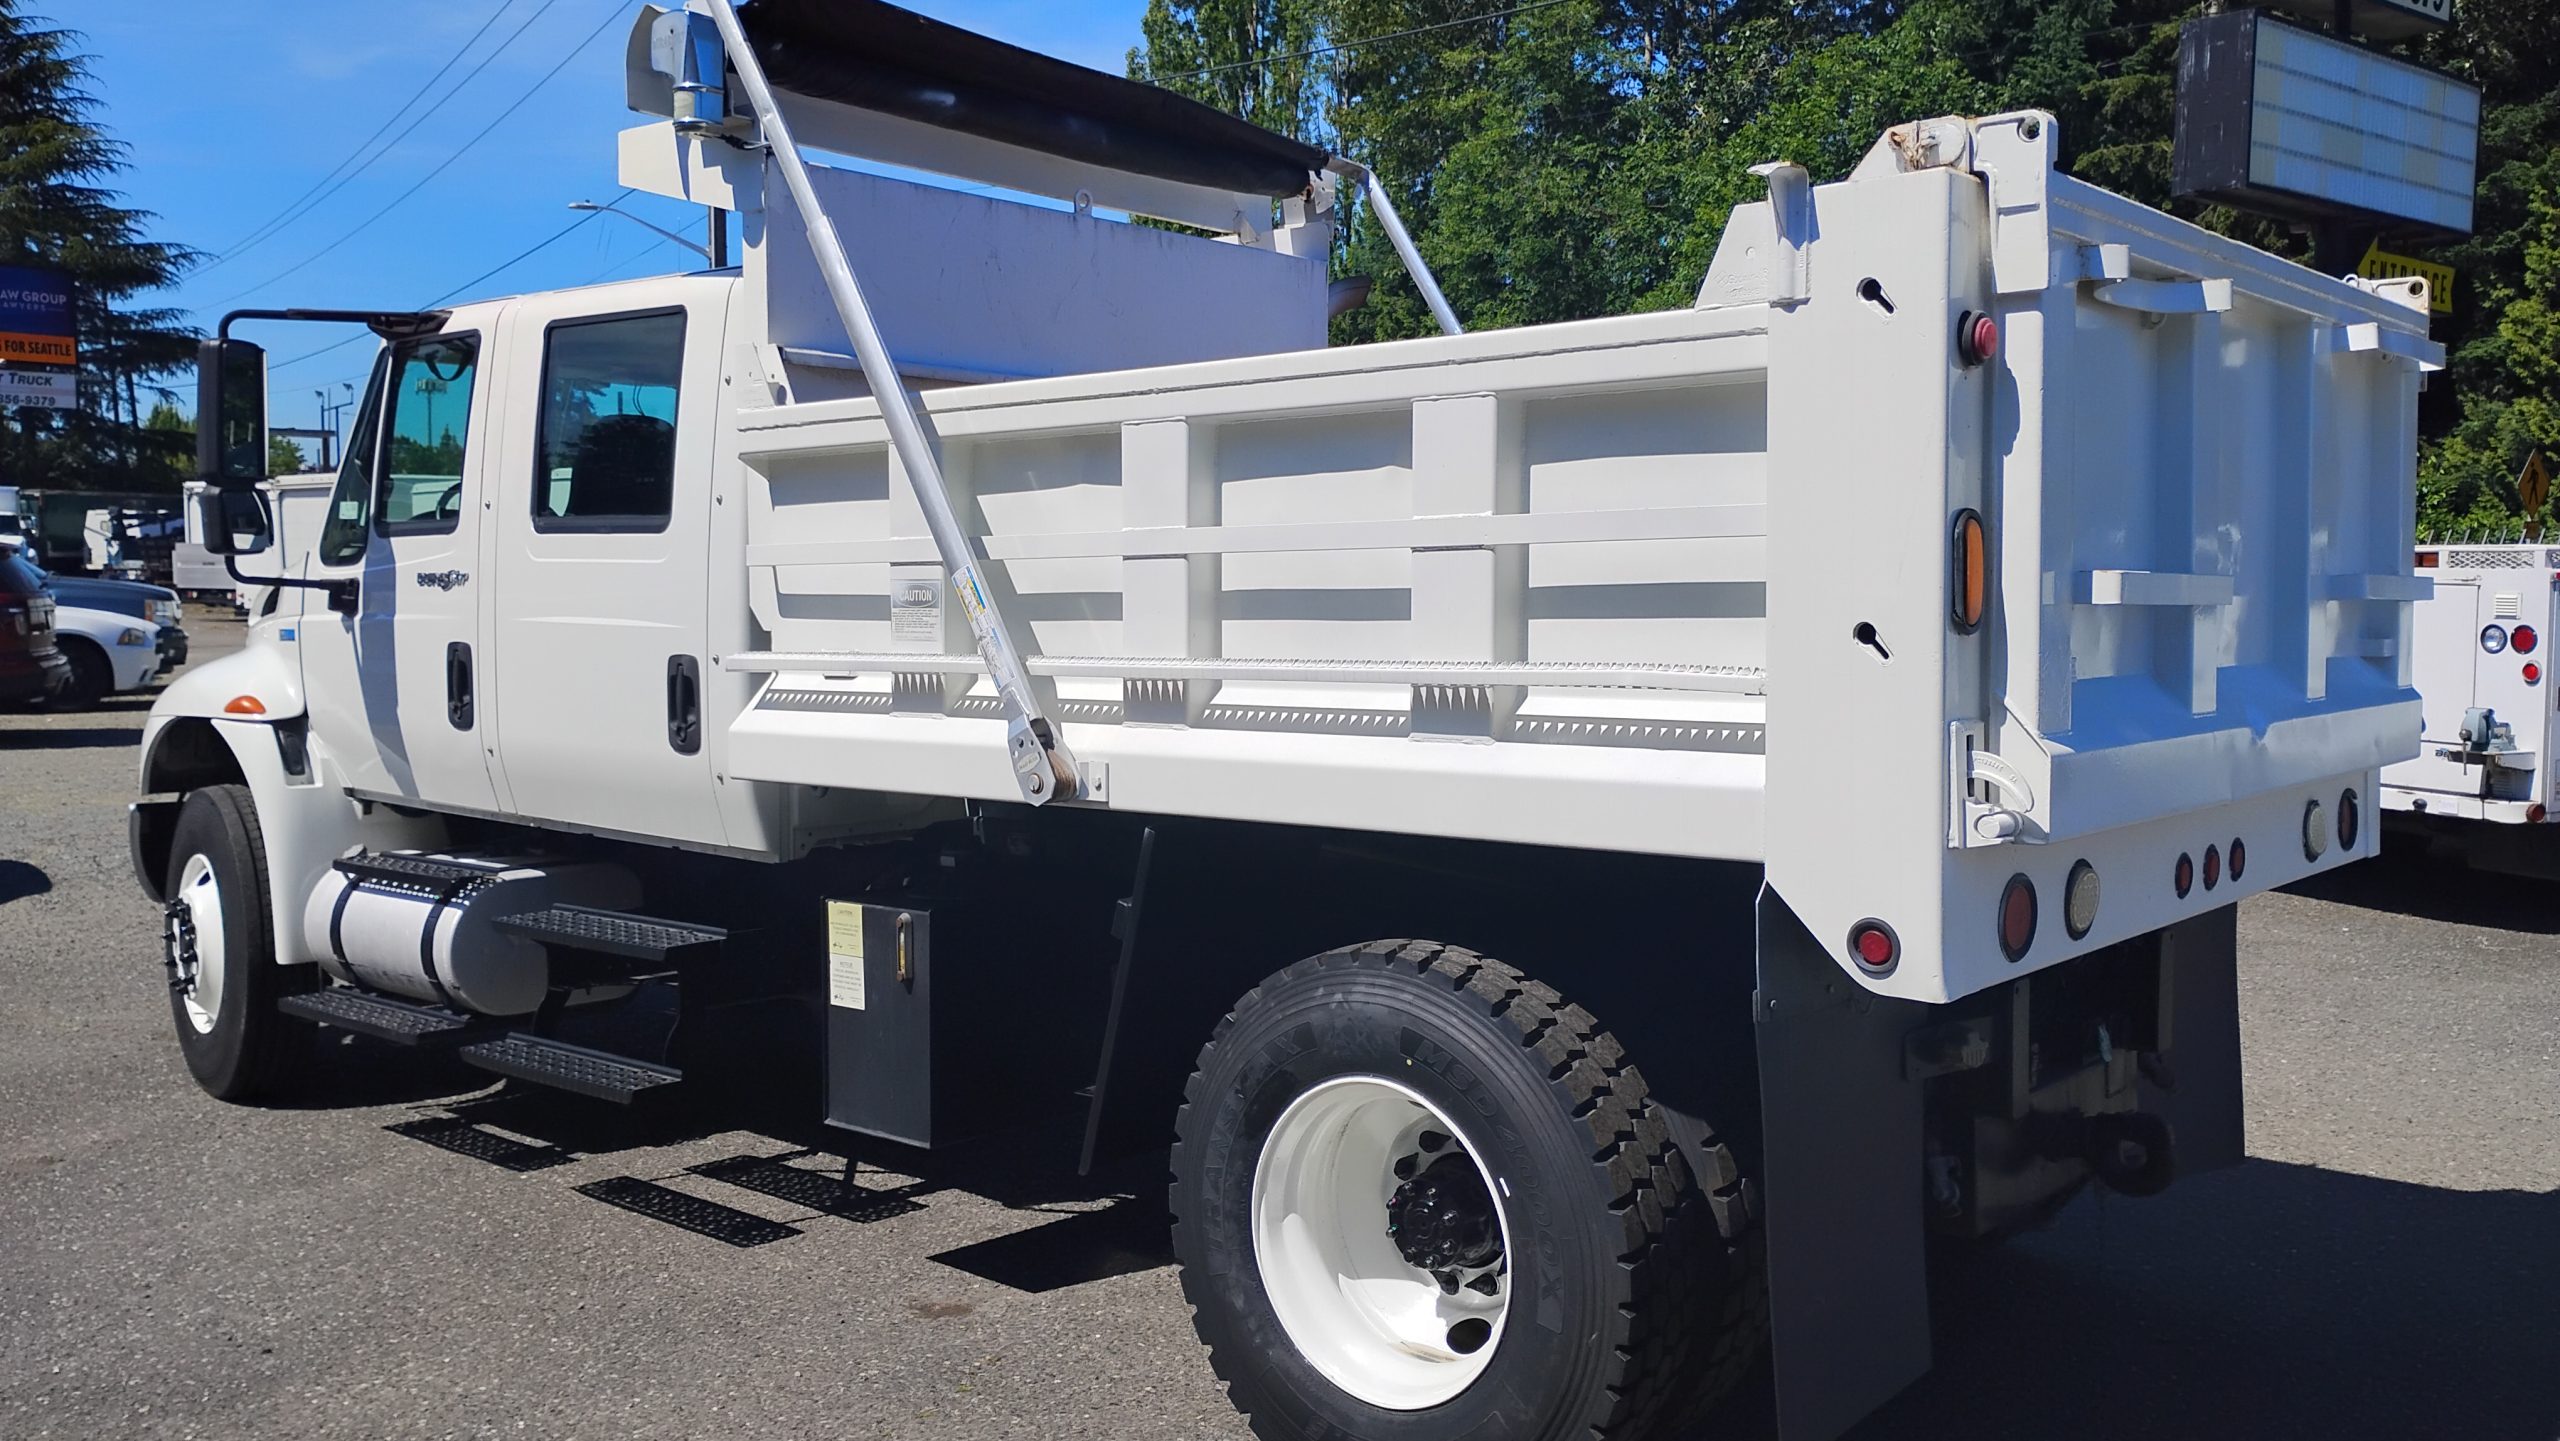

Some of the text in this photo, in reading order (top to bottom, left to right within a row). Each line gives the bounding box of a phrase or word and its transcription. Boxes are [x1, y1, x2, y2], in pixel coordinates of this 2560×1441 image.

[2369, 260, 2448, 304] ENTCE
[22, 291, 67, 305] GROUP
[4, 340, 25, 353] FOR
[28, 341, 71, 356] SEATTLE
[9, 372, 53, 386] TRUCK
[900, 589, 933, 601] CAUTION
